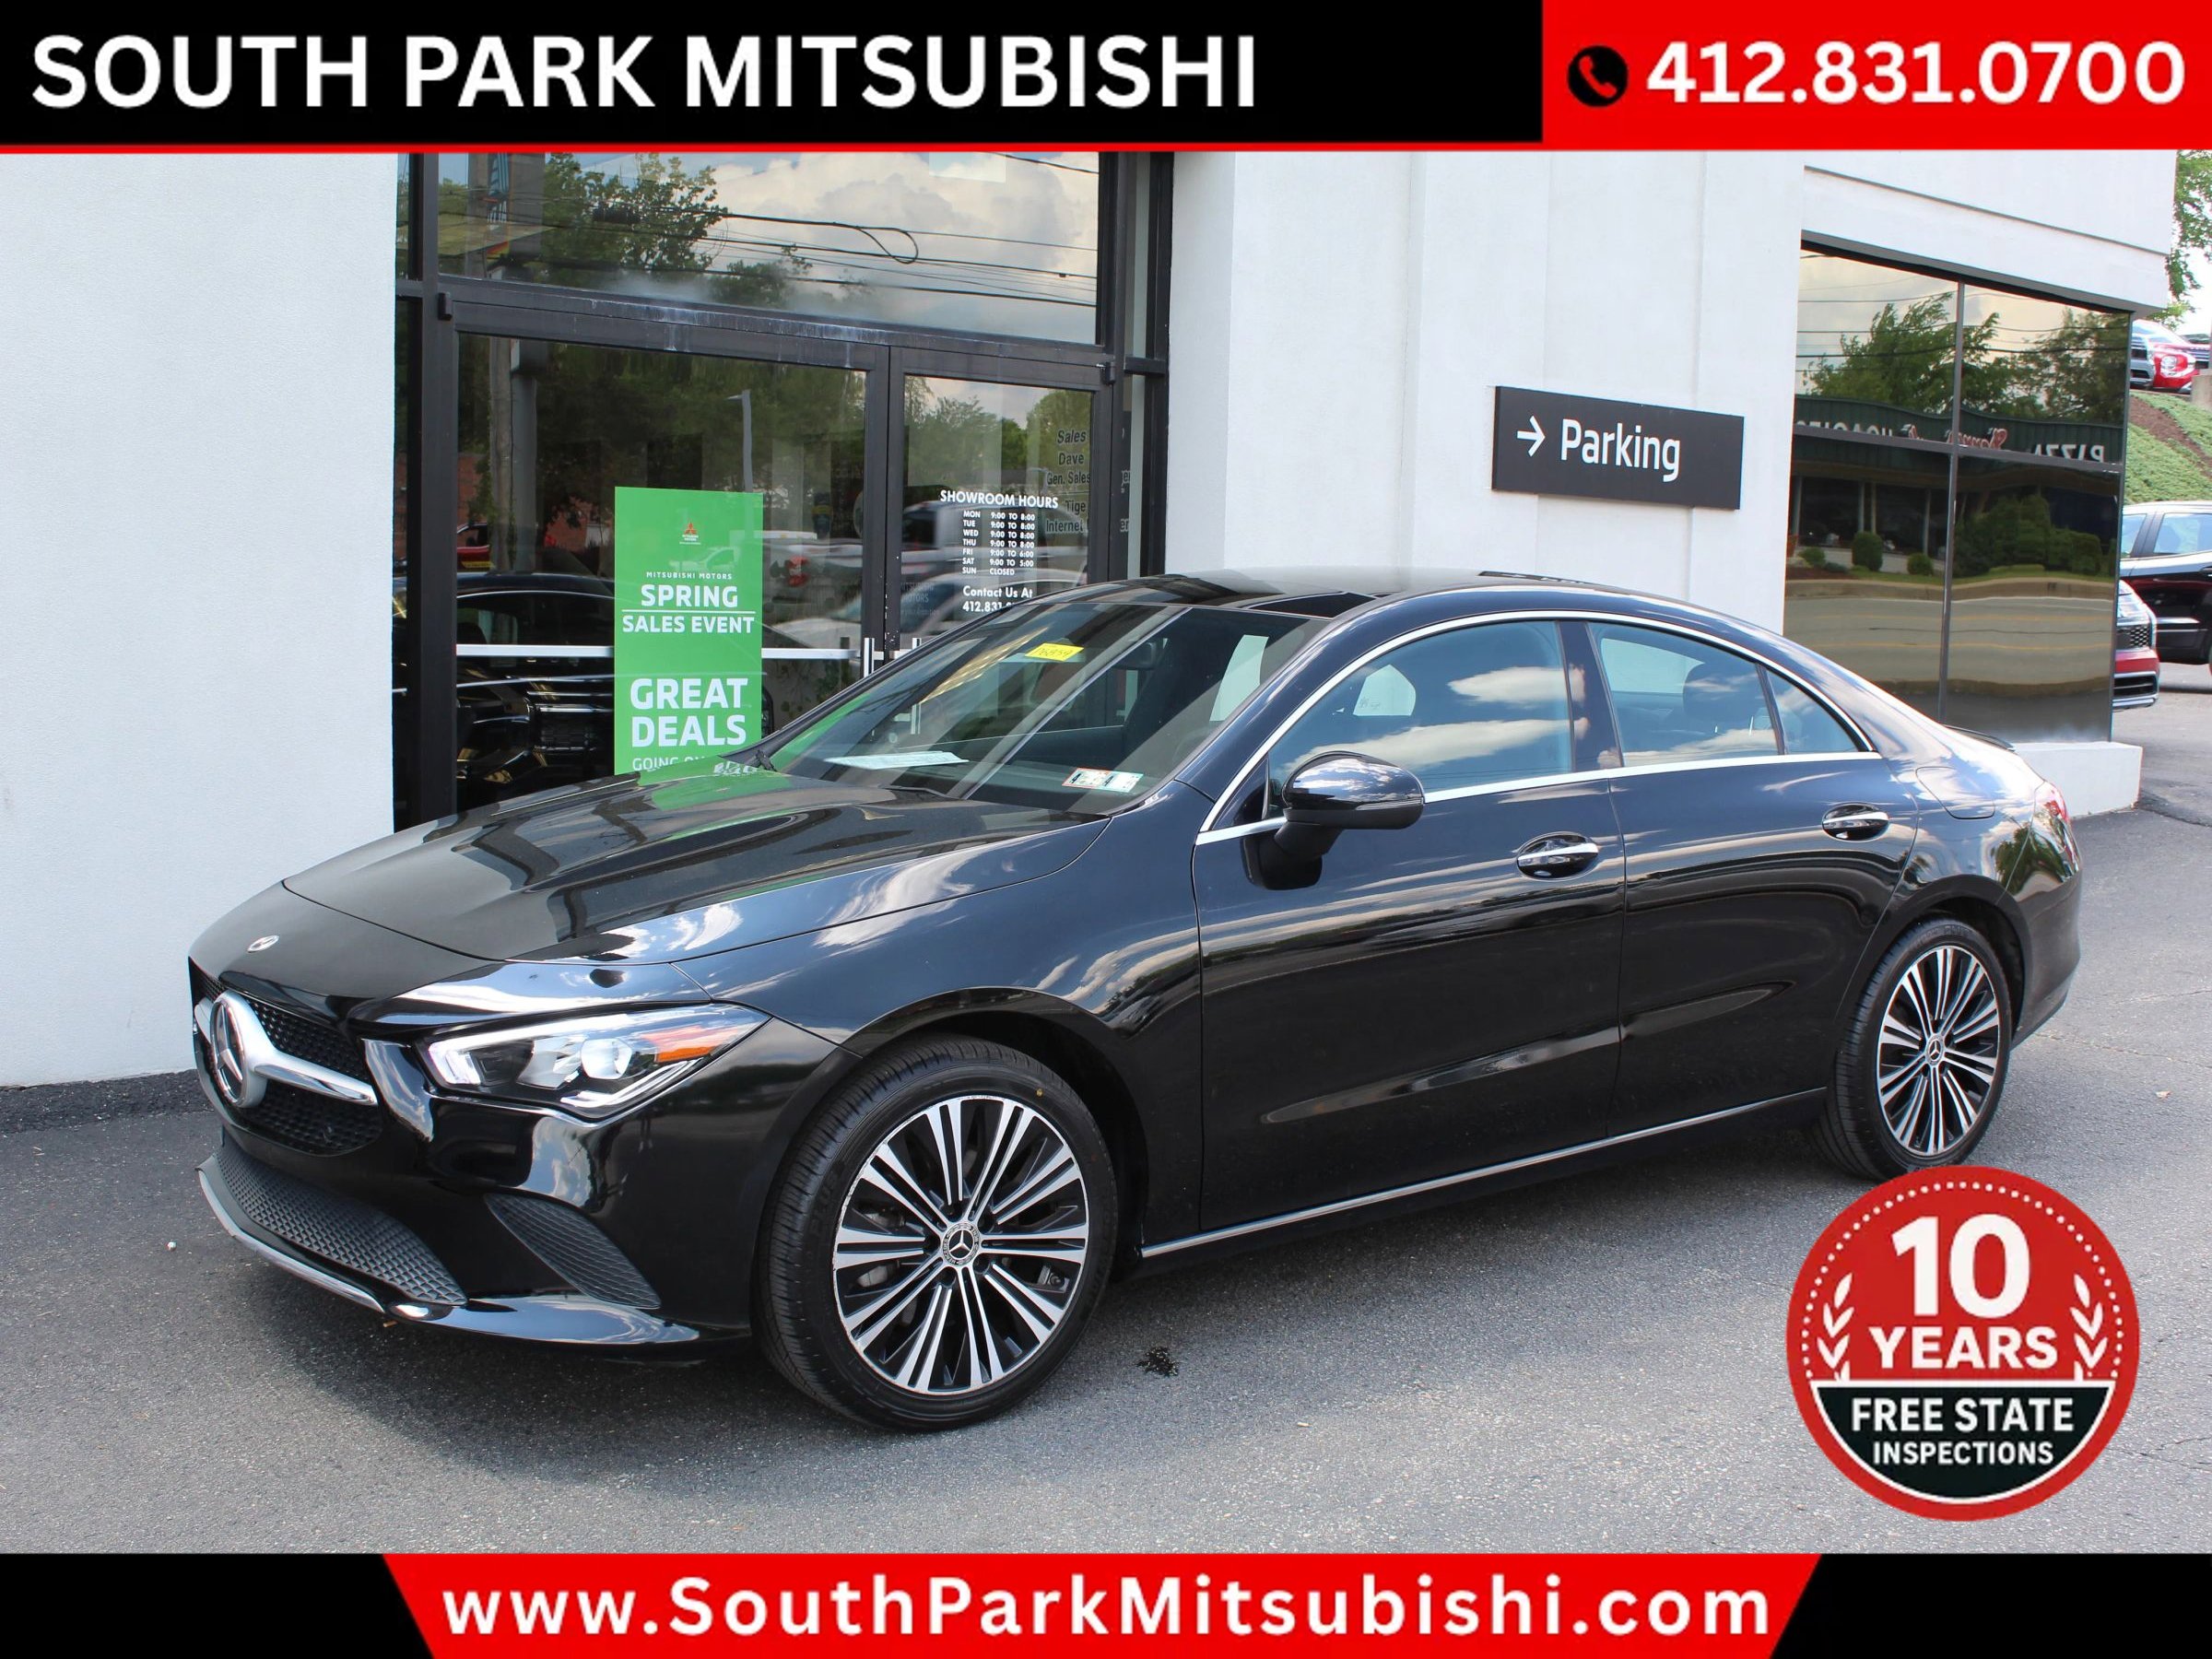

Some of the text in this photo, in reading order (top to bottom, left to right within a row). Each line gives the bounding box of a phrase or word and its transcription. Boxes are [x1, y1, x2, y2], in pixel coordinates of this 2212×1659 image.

[1057, 429, 1087, 443] Sales
[1058, 453, 1085, 465] Dave
[1560, 418, 1680, 482] Parking
[1047, 471, 1091, 485] Gen. Sales
[940, 489, 1059, 509] SHOWROOM HOURS
[641, 583, 738, 609] SPRING
[962, 585, 1033, 598] Contact Us At
[622, 614, 755, 633] SALES EVENT
[629, 677, 748, 710] GREAT
[631, 714, 747, 747] DEALS
